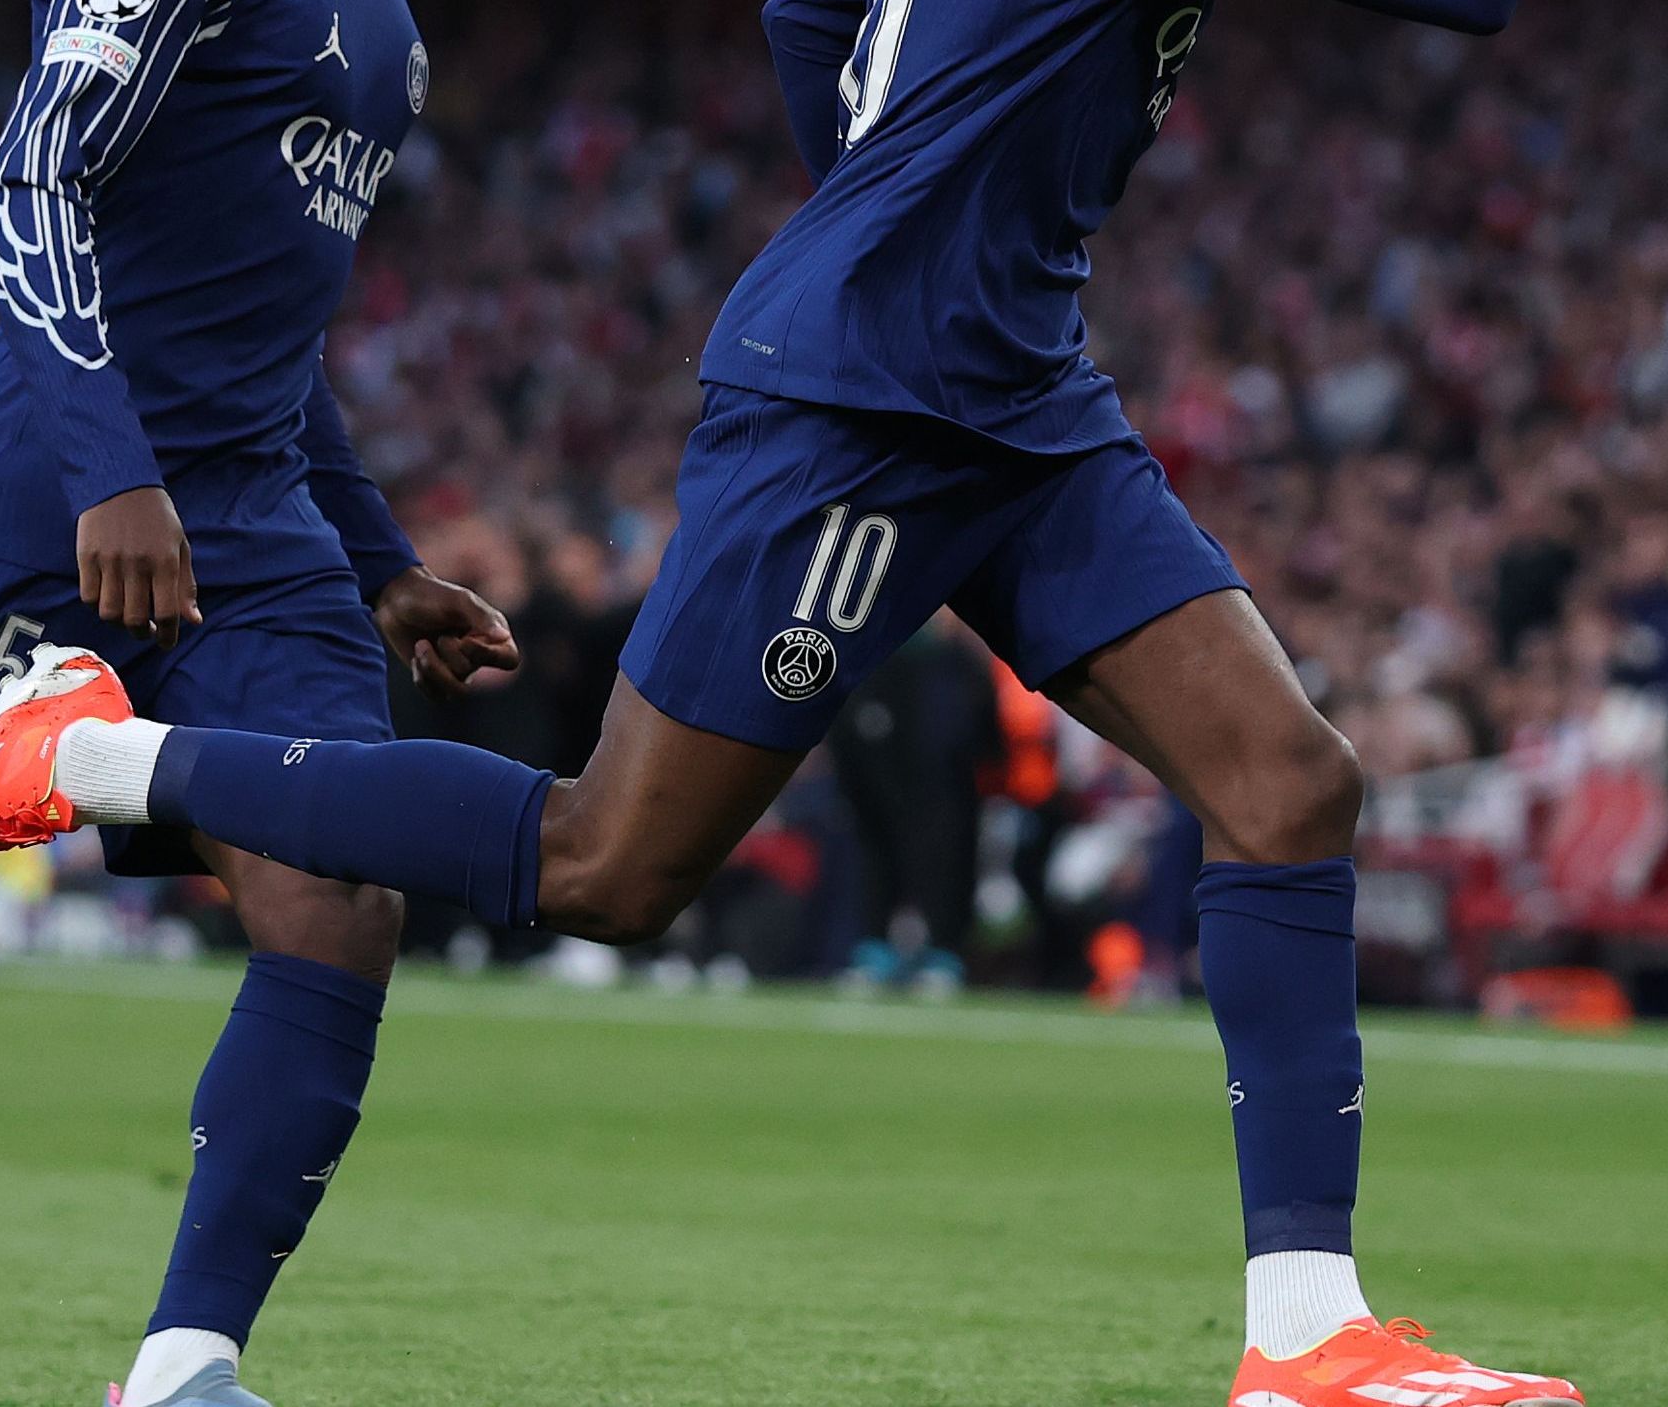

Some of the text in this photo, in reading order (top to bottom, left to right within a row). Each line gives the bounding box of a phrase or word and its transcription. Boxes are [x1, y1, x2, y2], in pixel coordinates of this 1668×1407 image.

[280, 115, 395, 207] QATAR
[791, 502, 898, 633] 10
[783, 631, 830, 655] PARIS
